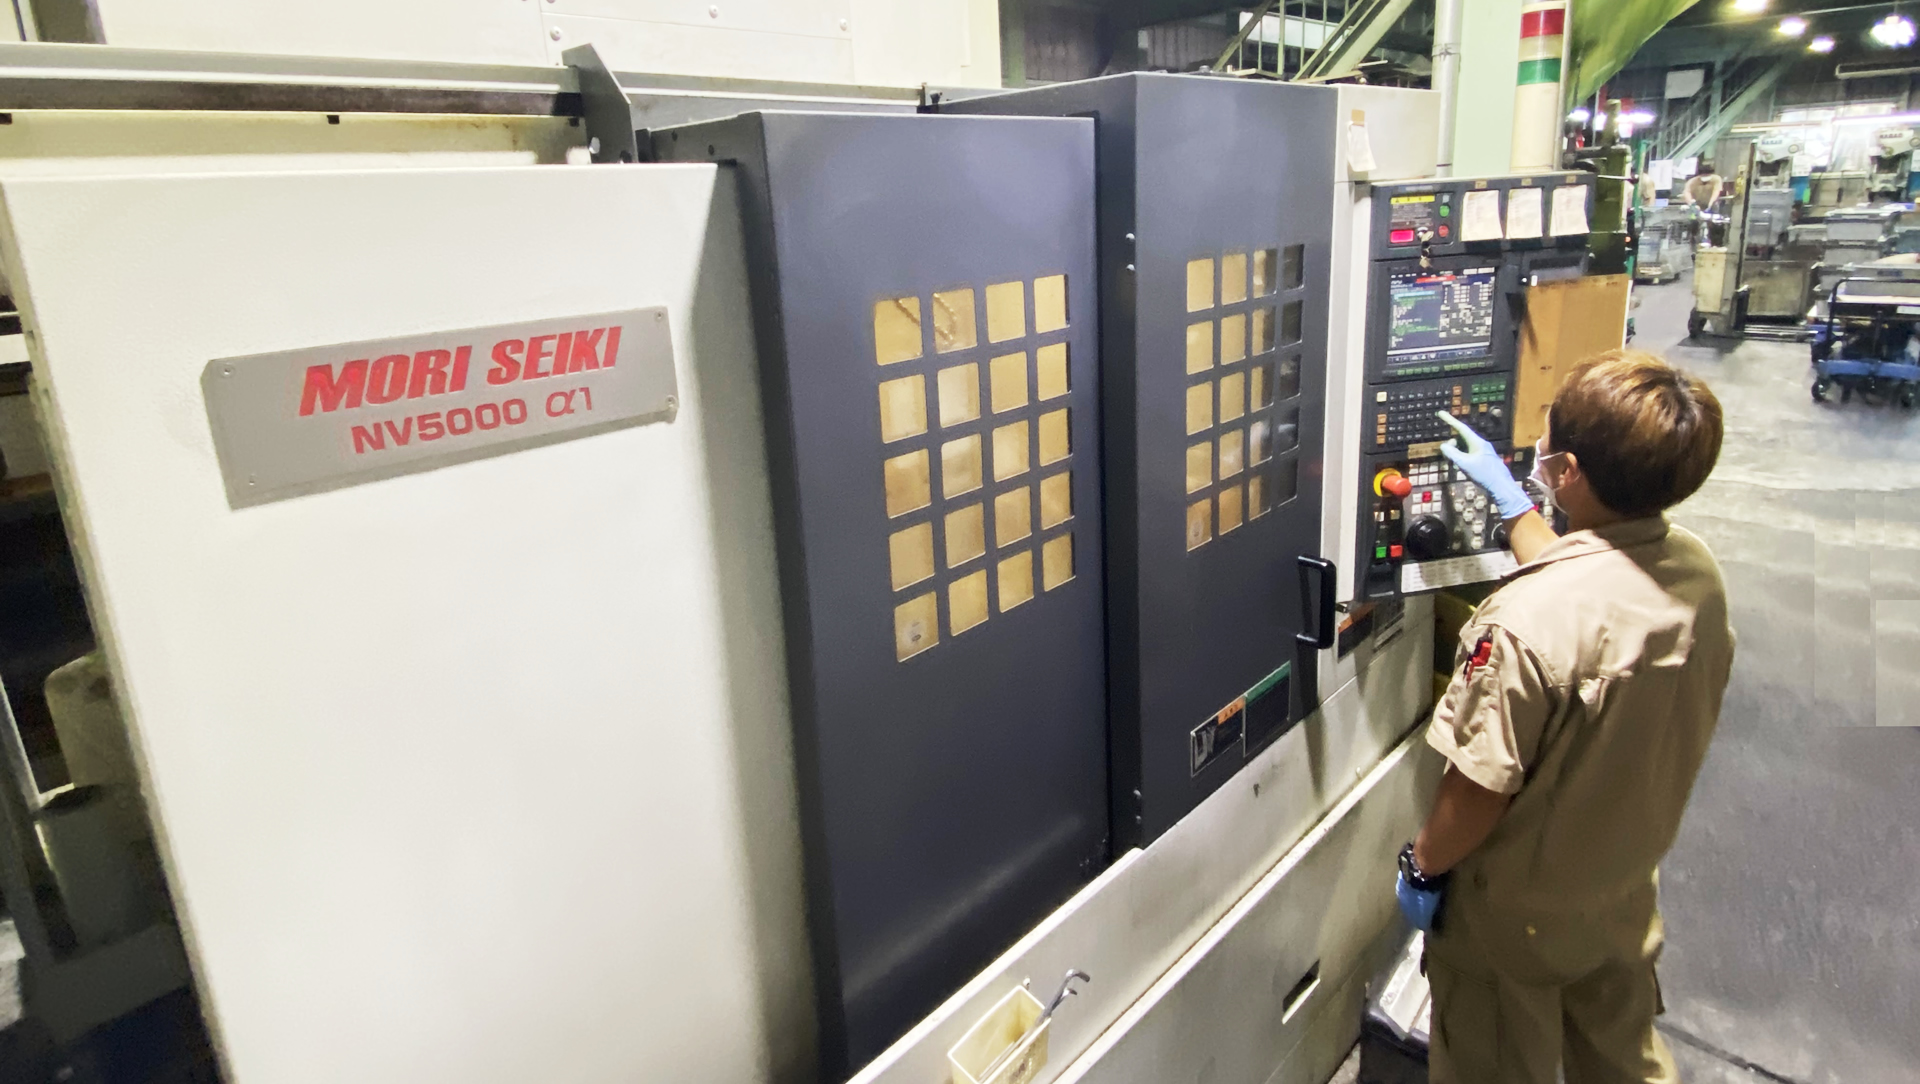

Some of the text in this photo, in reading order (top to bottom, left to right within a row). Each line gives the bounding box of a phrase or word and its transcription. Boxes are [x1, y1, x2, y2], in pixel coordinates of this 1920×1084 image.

[299, 326, 622, 417] MORI SEIKI
[350, 398, 528, 454] NV5000
